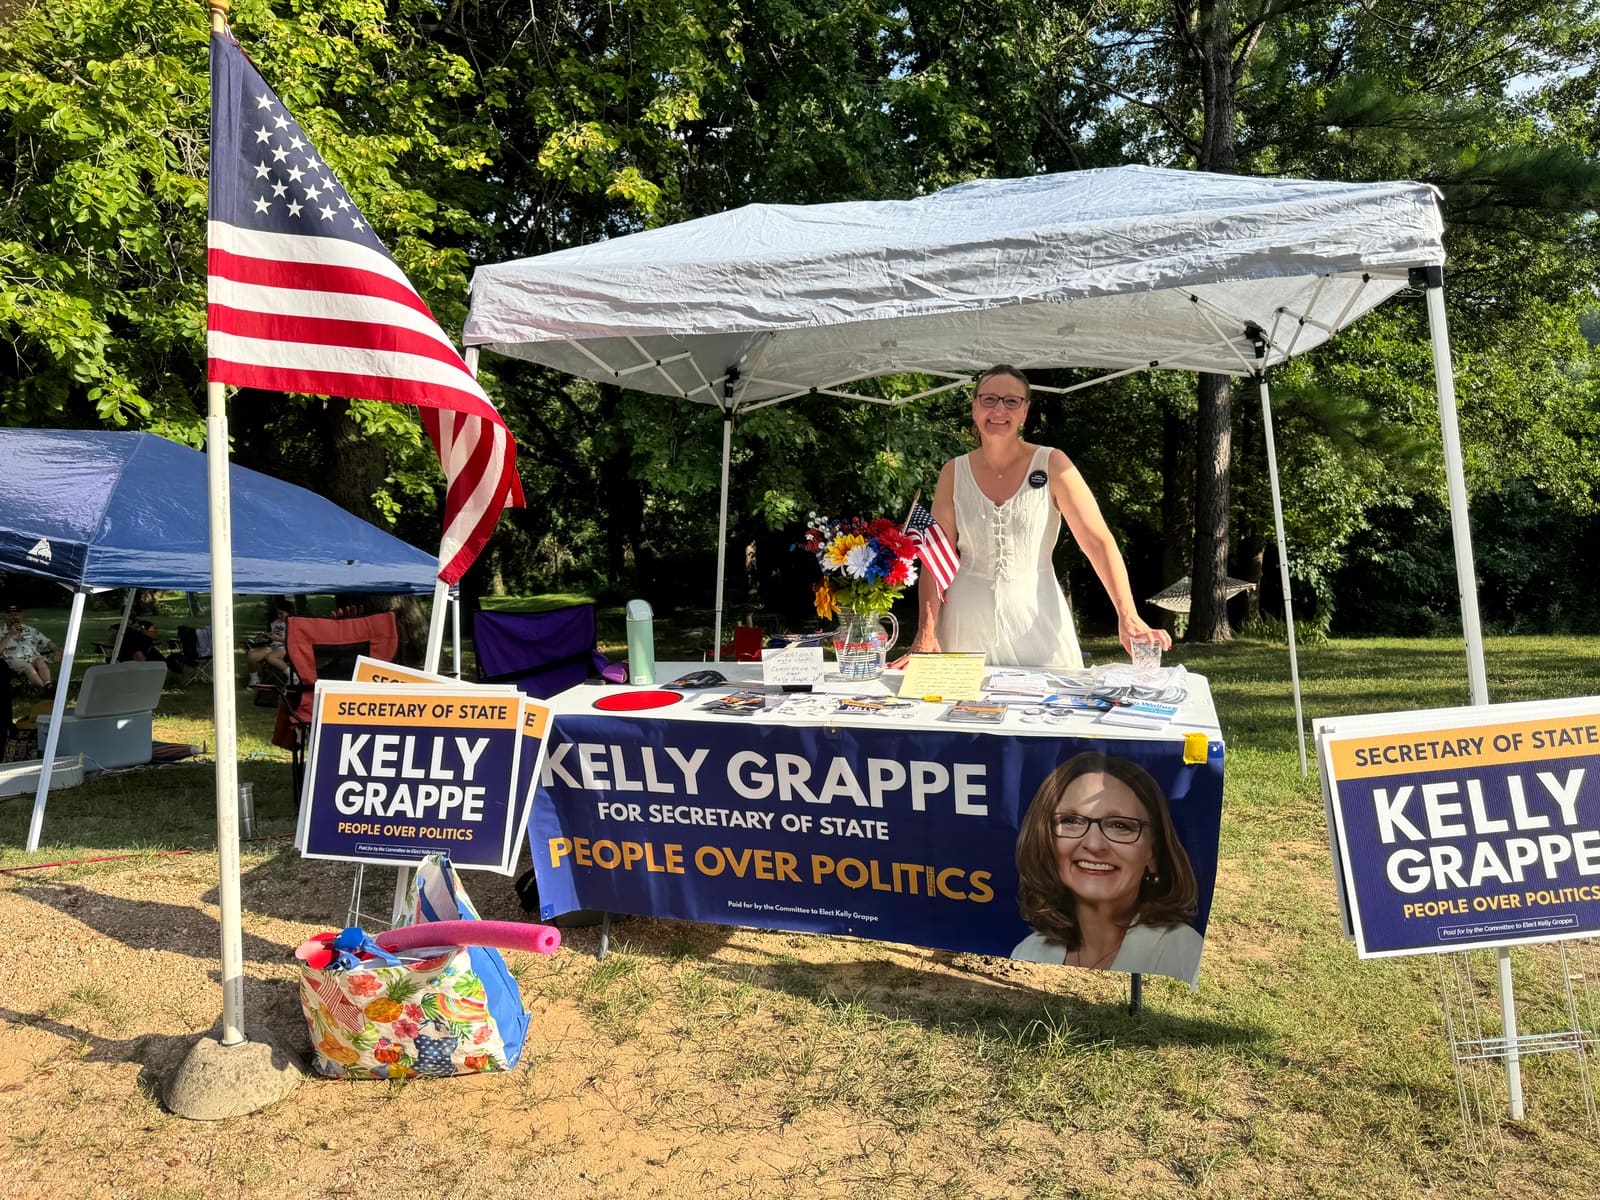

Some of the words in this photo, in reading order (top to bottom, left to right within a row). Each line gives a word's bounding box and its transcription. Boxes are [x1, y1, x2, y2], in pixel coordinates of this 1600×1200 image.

[337, 702, 427, 718] SECRETARY
[432, 704, 454, 719] OF
[459, 704, 508, 720] STATE
[338, 733, 490, 781] KELLY
[1355, 736, 1484, 766] SECRETARY
[1493, 733, 1523, 752] OF
[1531, 726, 1598, 748] STATE
[541, 743, 710, 795] KELLY
[726, 750, 988, 816] GRAPPE
[334, 781, 486, 822] GRAPPE
[598, 802, 640, 822] FOR
[648, 804, 775, 831] SECRETARY
[780, 813, 812, 833] OF
[820, 817, 889, 840] STATE
[1372, 768, 1586, 844] KELLY
[338, 822, 380, 836] PEOPLE
[384, 825, 416, 838] OVER
[419, 828, 473, 840] POLITICS
[548, 836, 684, 874] PEOPLE
[694, 846, 802, 883] OVER
[812, 854, 995, 903] POLITICS
[1386, 830, 1600, 894] GRAPPE
[728, 900, 742, 908] Paid
[754, 902, 762, 910] by
[775, 904, 809, 914] Committee
[819, 908, 834, 916] Elect
[835, 910, 852, 918] Kelly
[853, 912, 878, 922] Grappe
[1404, 900, 1468, 918] PEOPLE
[1473, 894, 1520, 911] OVER
[1526, 886, 1600, 906] POLITICS
[1457, 928, 1465, 936] for
[1466, 927, 1473, 935] by
[1484, 924, 1515, 932] Committee
[1538, 920, 1551, 928] Kelly
[1552, 918, 1573, 926] Grappe
